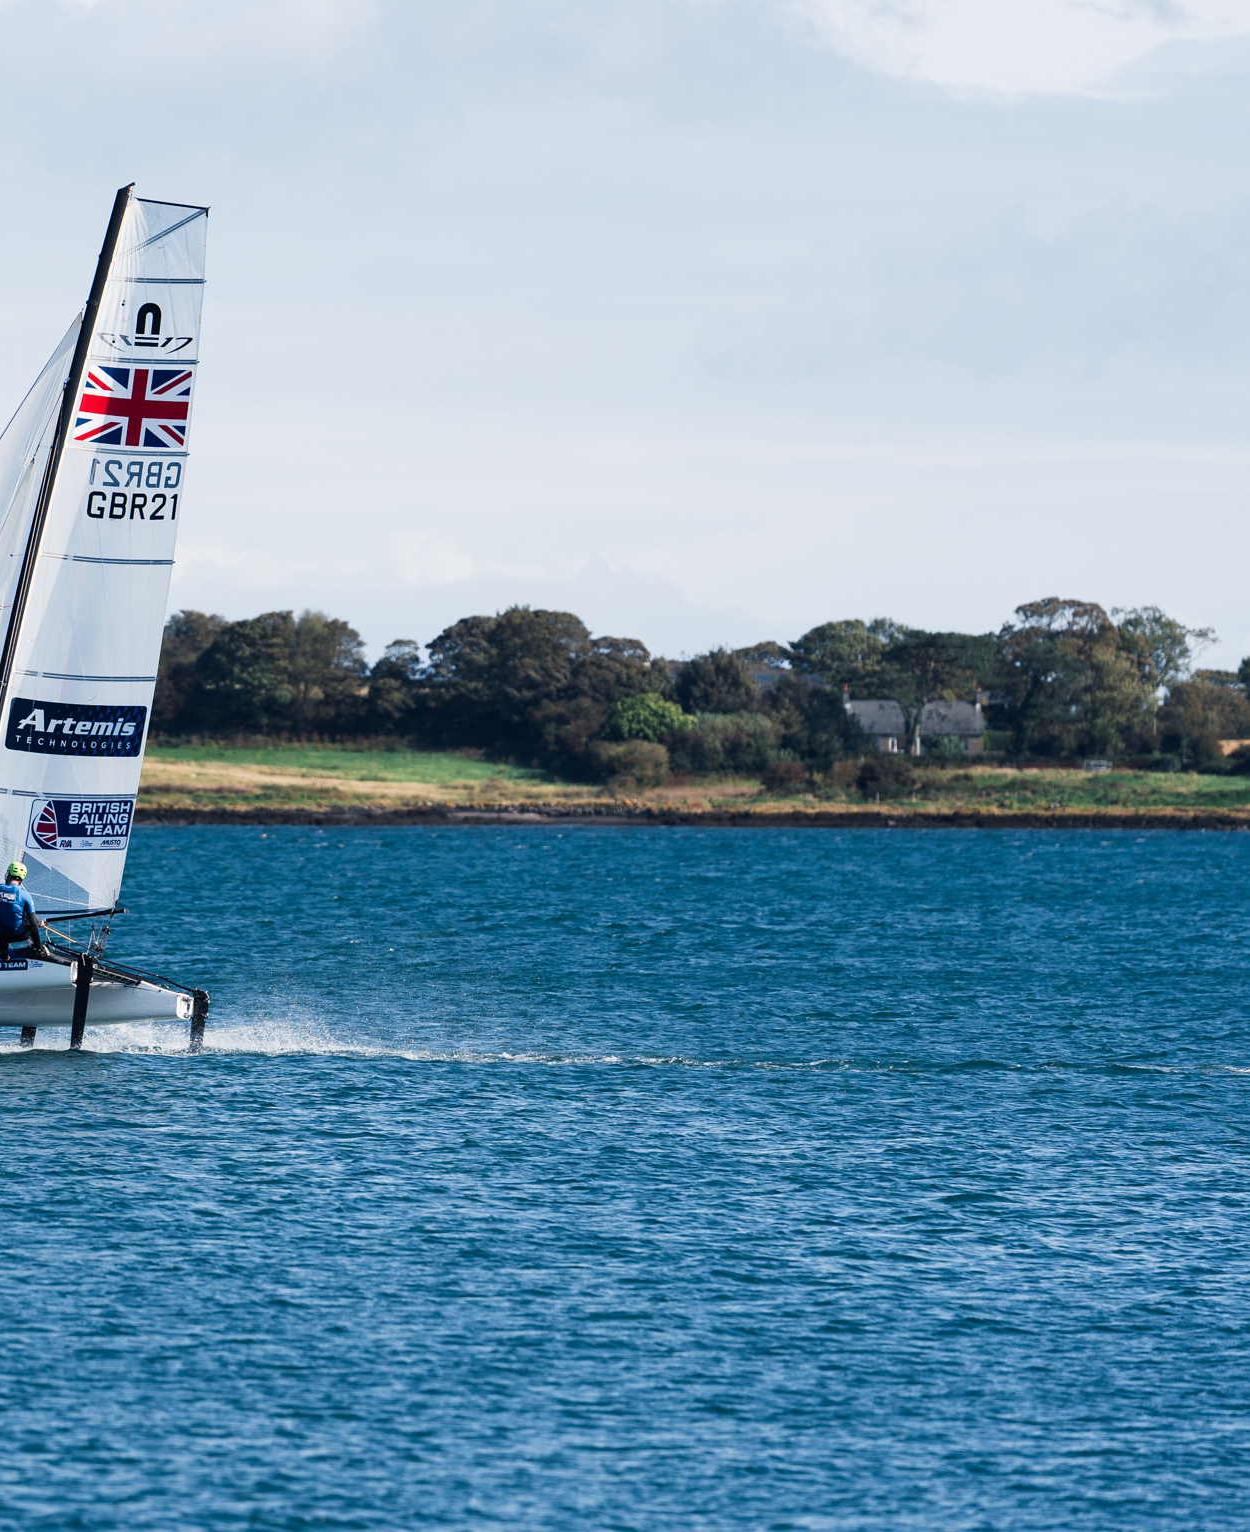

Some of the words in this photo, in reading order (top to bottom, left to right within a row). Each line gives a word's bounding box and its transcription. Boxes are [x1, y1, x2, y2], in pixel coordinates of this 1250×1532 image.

[87, 491, 178, 520] GBR21
[17, 708, 137, 736] Artemis
[15, 734, 131, 750] TECHNOLOGIES
[70, 802, 131, 813] BRITISH
[68, 813, 129, 825] SAILING
[85, 825, 127, 836] TEAM
